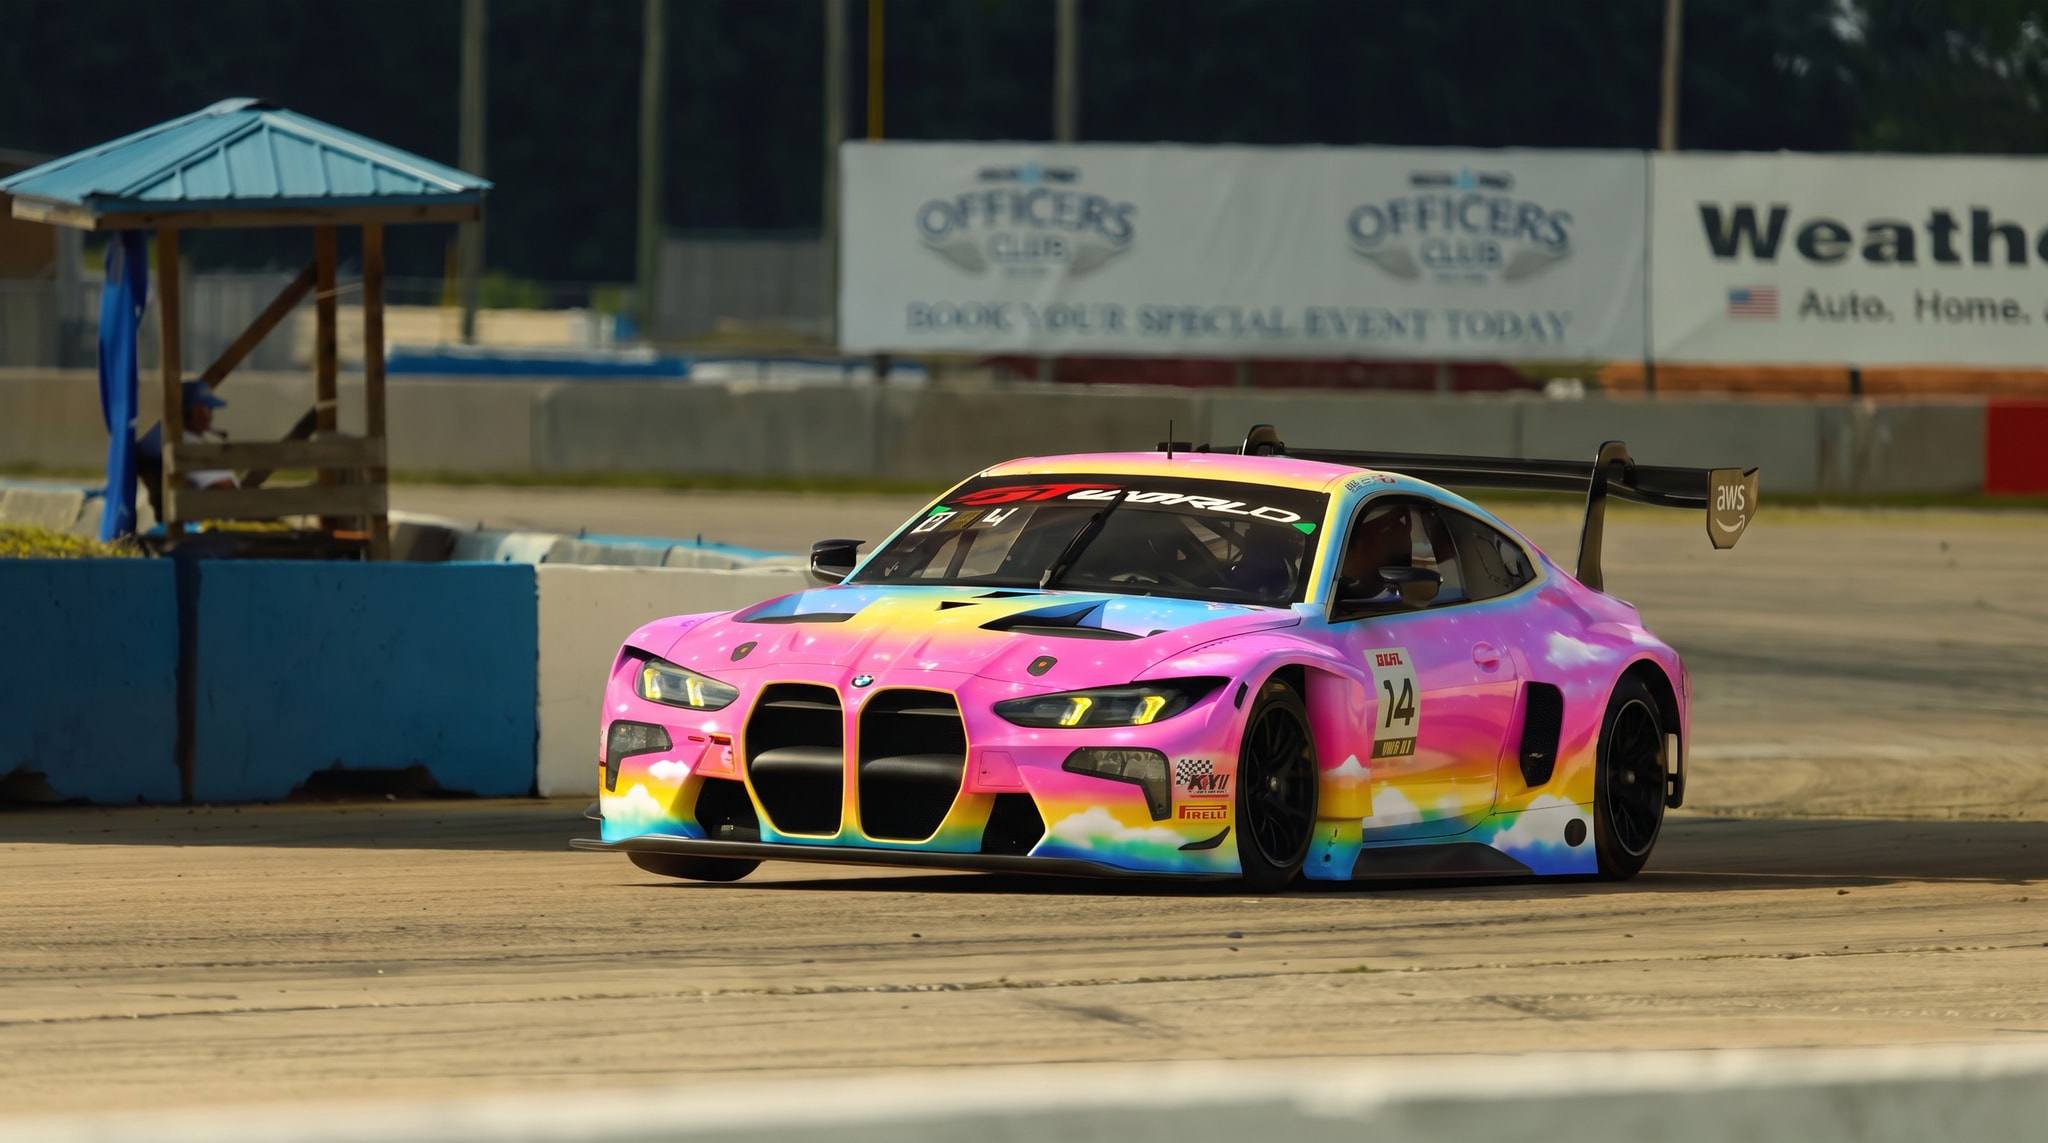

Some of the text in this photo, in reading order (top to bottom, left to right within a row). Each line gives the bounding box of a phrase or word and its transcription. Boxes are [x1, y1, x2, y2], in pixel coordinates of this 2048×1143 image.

[918, 188, 1136, 243] OFFICERS
[1348, 192, 1573, 250] OFFICERS
[1697, 201, 2048, 266] Weath
[988, 233, 1071, 262] CLUB
[1420, 239, 1504, 269] CLUB
[906, 301, 1574, 343] BOOK YOUR SPECIAL EVENT TODAY
[1716, 484, 1745, 511] aws
[1383, 678, 1415, 728] 14
[1179, 805, 1228, 819] PIRELLI
